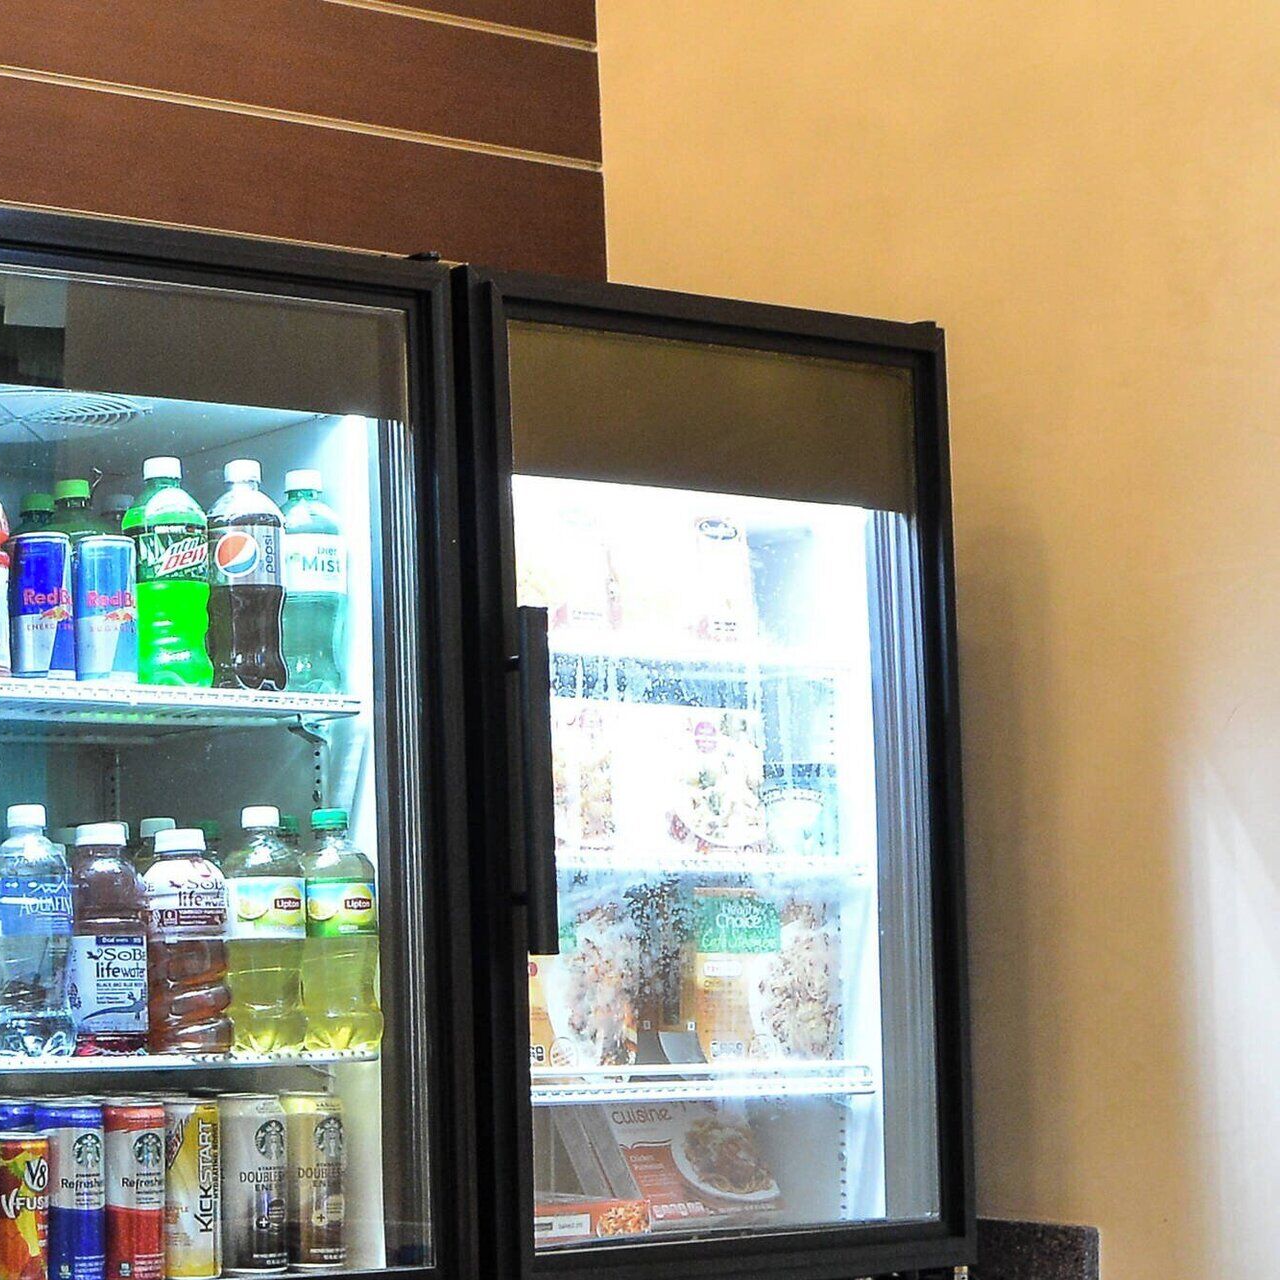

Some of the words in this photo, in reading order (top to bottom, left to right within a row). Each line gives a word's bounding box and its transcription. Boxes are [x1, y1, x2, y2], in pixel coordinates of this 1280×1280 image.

[265, 535, 276, 574] pepsi
[24, 588, 56, 606] Red
[275, 899, 300, 909] Lipton
[345, 899, 370, 909] Lipton
[612, 1107, 672, 1125] cuisine
[26, 1156, 46, 1188] V8
[194, 1120, 214, 1233] KICKSTART
